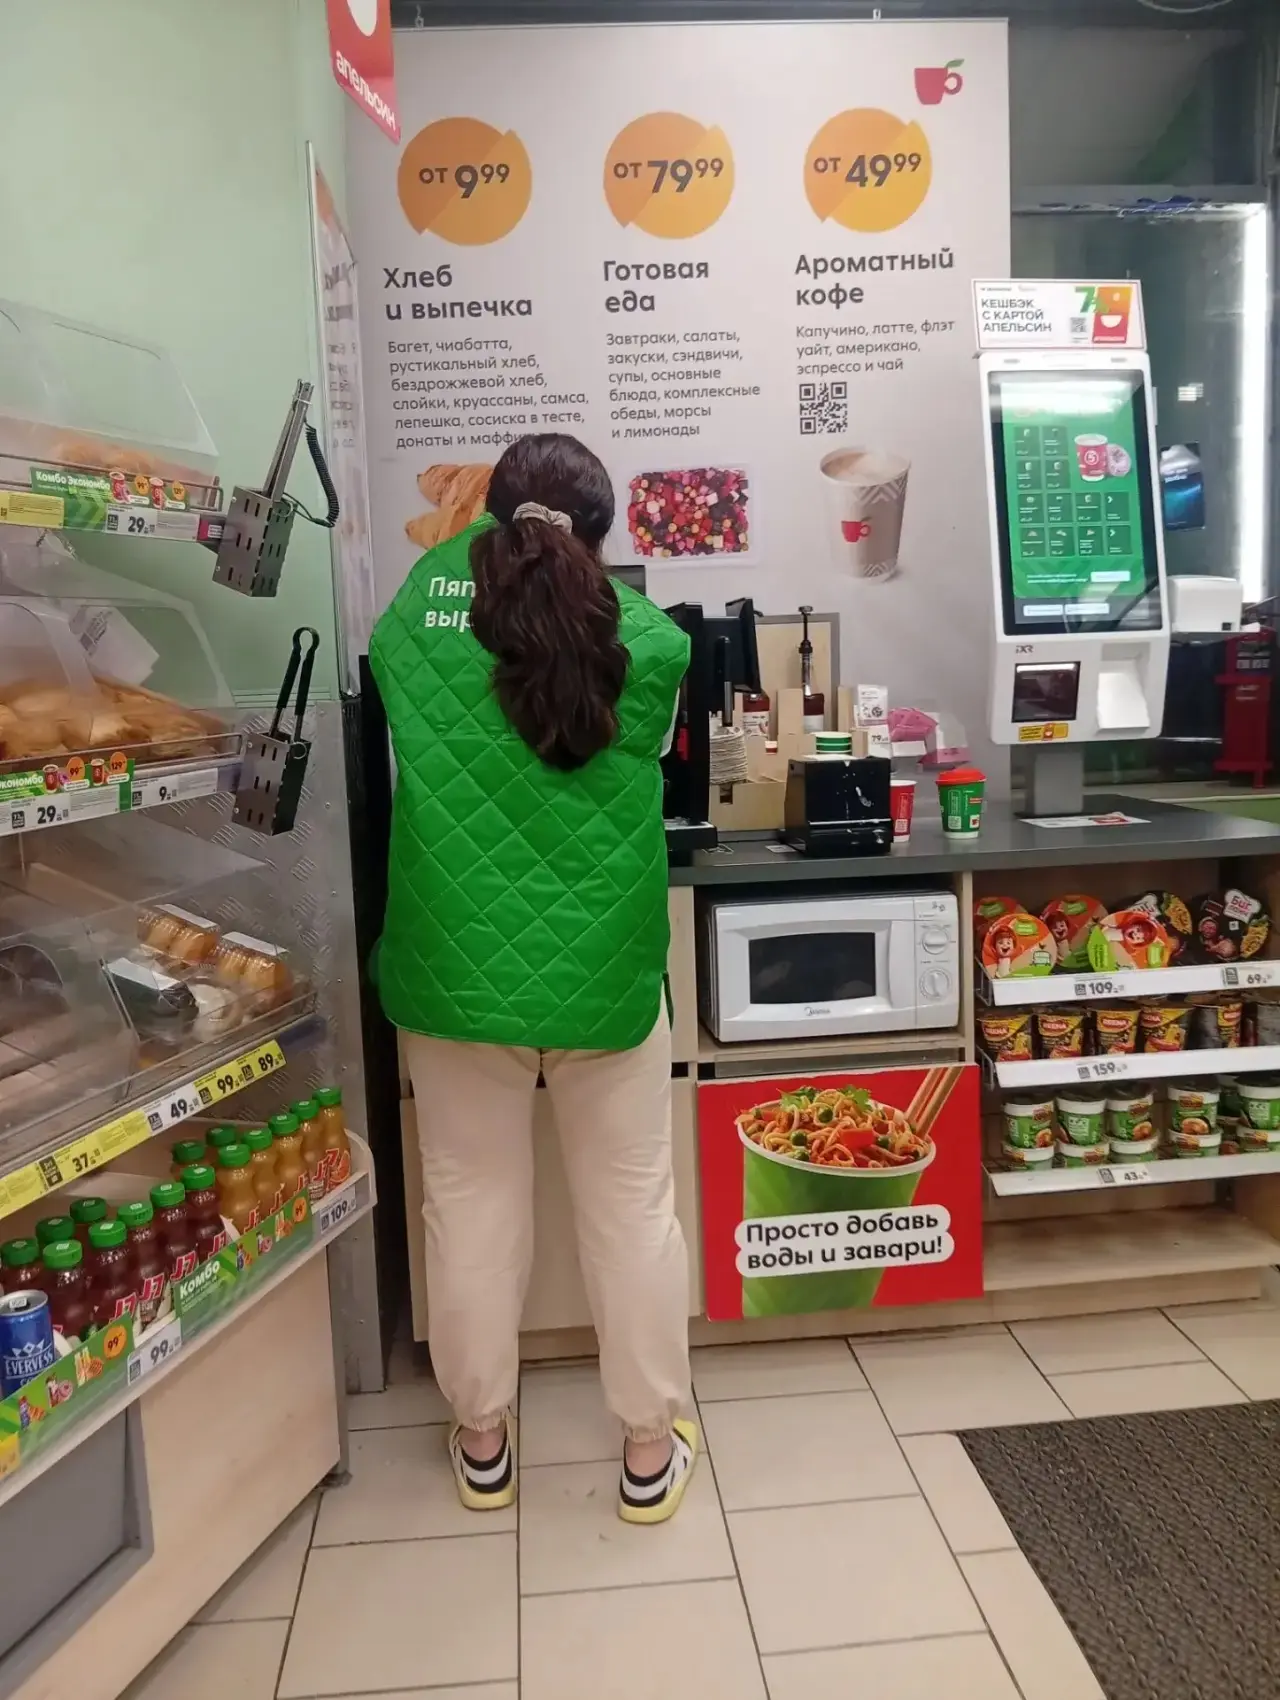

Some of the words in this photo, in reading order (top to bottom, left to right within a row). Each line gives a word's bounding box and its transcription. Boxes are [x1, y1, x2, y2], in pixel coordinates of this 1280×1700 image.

[336, 50, 396, 132] апельсин
[604, 260, 709, 281] Готовая
[795, 247, 954, 280] Ароматный
[383, 264, 453, 289] Хлеб
[605, 290, 655, 313] еда
[796, 283, 864, 309] кофе
[981, 298, 1034, 309] КЕШБЭК
[385, 304, 402, 320] и
[411, 299, 532, 320] выпечка
[982, 310, 991, 320] С
[994, 308, 1044, 320] КАРТОЙ
[796, 325, 869, 340] Капучино,
[872, 322, 917, 335] латте,
[921, 319, 955, 335] флэт
[983, 322, 1052, 332] АПЕЛЬСИН
[388, 341, 432, 354] Багет,
[436, 338, 512, 352] чиабатта,
[606, 332, 679, 347] Завтраки,
[683, 330, 740, 343] салаты,
[607, 352, 668, 366] закуски,
[672, 349, 743, 362] сэндвичи,
[796, 344, 832, 359] уайт,
[836, 341, 921, 356] американо,
[390, 357, 497, 375] рустикальный
[501, 355, 540, 369] хлеб,
[797, 361, 861, 377] эспрессо
[866, 362, 873, 371] и
[878, 358, 903, 370] чай
[391, 375, 504, 393] бездрожжевой
[509, 373, 547, 388] хлеб,
[608, 372, 647, 386] супы,
[651, 369, 721, 381] основные
[393, 396, 449, 410] слойки,
[453, 394, 537, 410] круассаны,
[541, 391, 589, 405] самса,
[609, 388, 660, 402] блюда,
[664, 385, 760, 400] комплексные
[395, 416, 464, 429] лепешка,
[468, 413, 526, 427] сосиска
[531, 414, 538, 423] в
[542, 411, 585, 424] тесте,
[610, 407, 660, 421] обеды,
[664, 406, 711, 419] морсы
[396, 434, 452, 449] донаты
[457, 434, 466, 444] и
[470, 431, 530, 446] маффи
[612, 429, 620, 438] и
[624, 425, 700, 439] лимонады
[36, 471, 66, 484] Комбо
[67, 475, 110, 490] Экономбо
[128, 516, 145, 533] 29
[0, 773, 43, 789] кономбо
[159, 786, 167, 801] 9
[37, 805, 56, 824] 29
[1089, 982, 1112, 994] 109
[258, 1053, 274, 1071] 89
[1092, 1062, 1116, 1076] 159
[217, 1074, 234, 1095] 99
[170, 1099, 187, 1119] 49
[72, 1152, 88, 1172] 37
[330, 1200, 348, 1222] 109
[746, 1220, 839, 1246] Просто
[847, 1212, 938, 1234] добавь
[748, 1247, 813, 1269] воды
[821, 1248, 836, 1263] и
[844, 1235, 943, 1261] завари!
[170, 1250, 198, 1282] J7
[139, 1273, 165, 1301] J7
[179, 1260, 220, 1299] Комбо
[107, 1336, 119, 1350] 99
[5, 1349, 53, 1376] EVERVESS
[150, 1340, 169, 1366] 99
